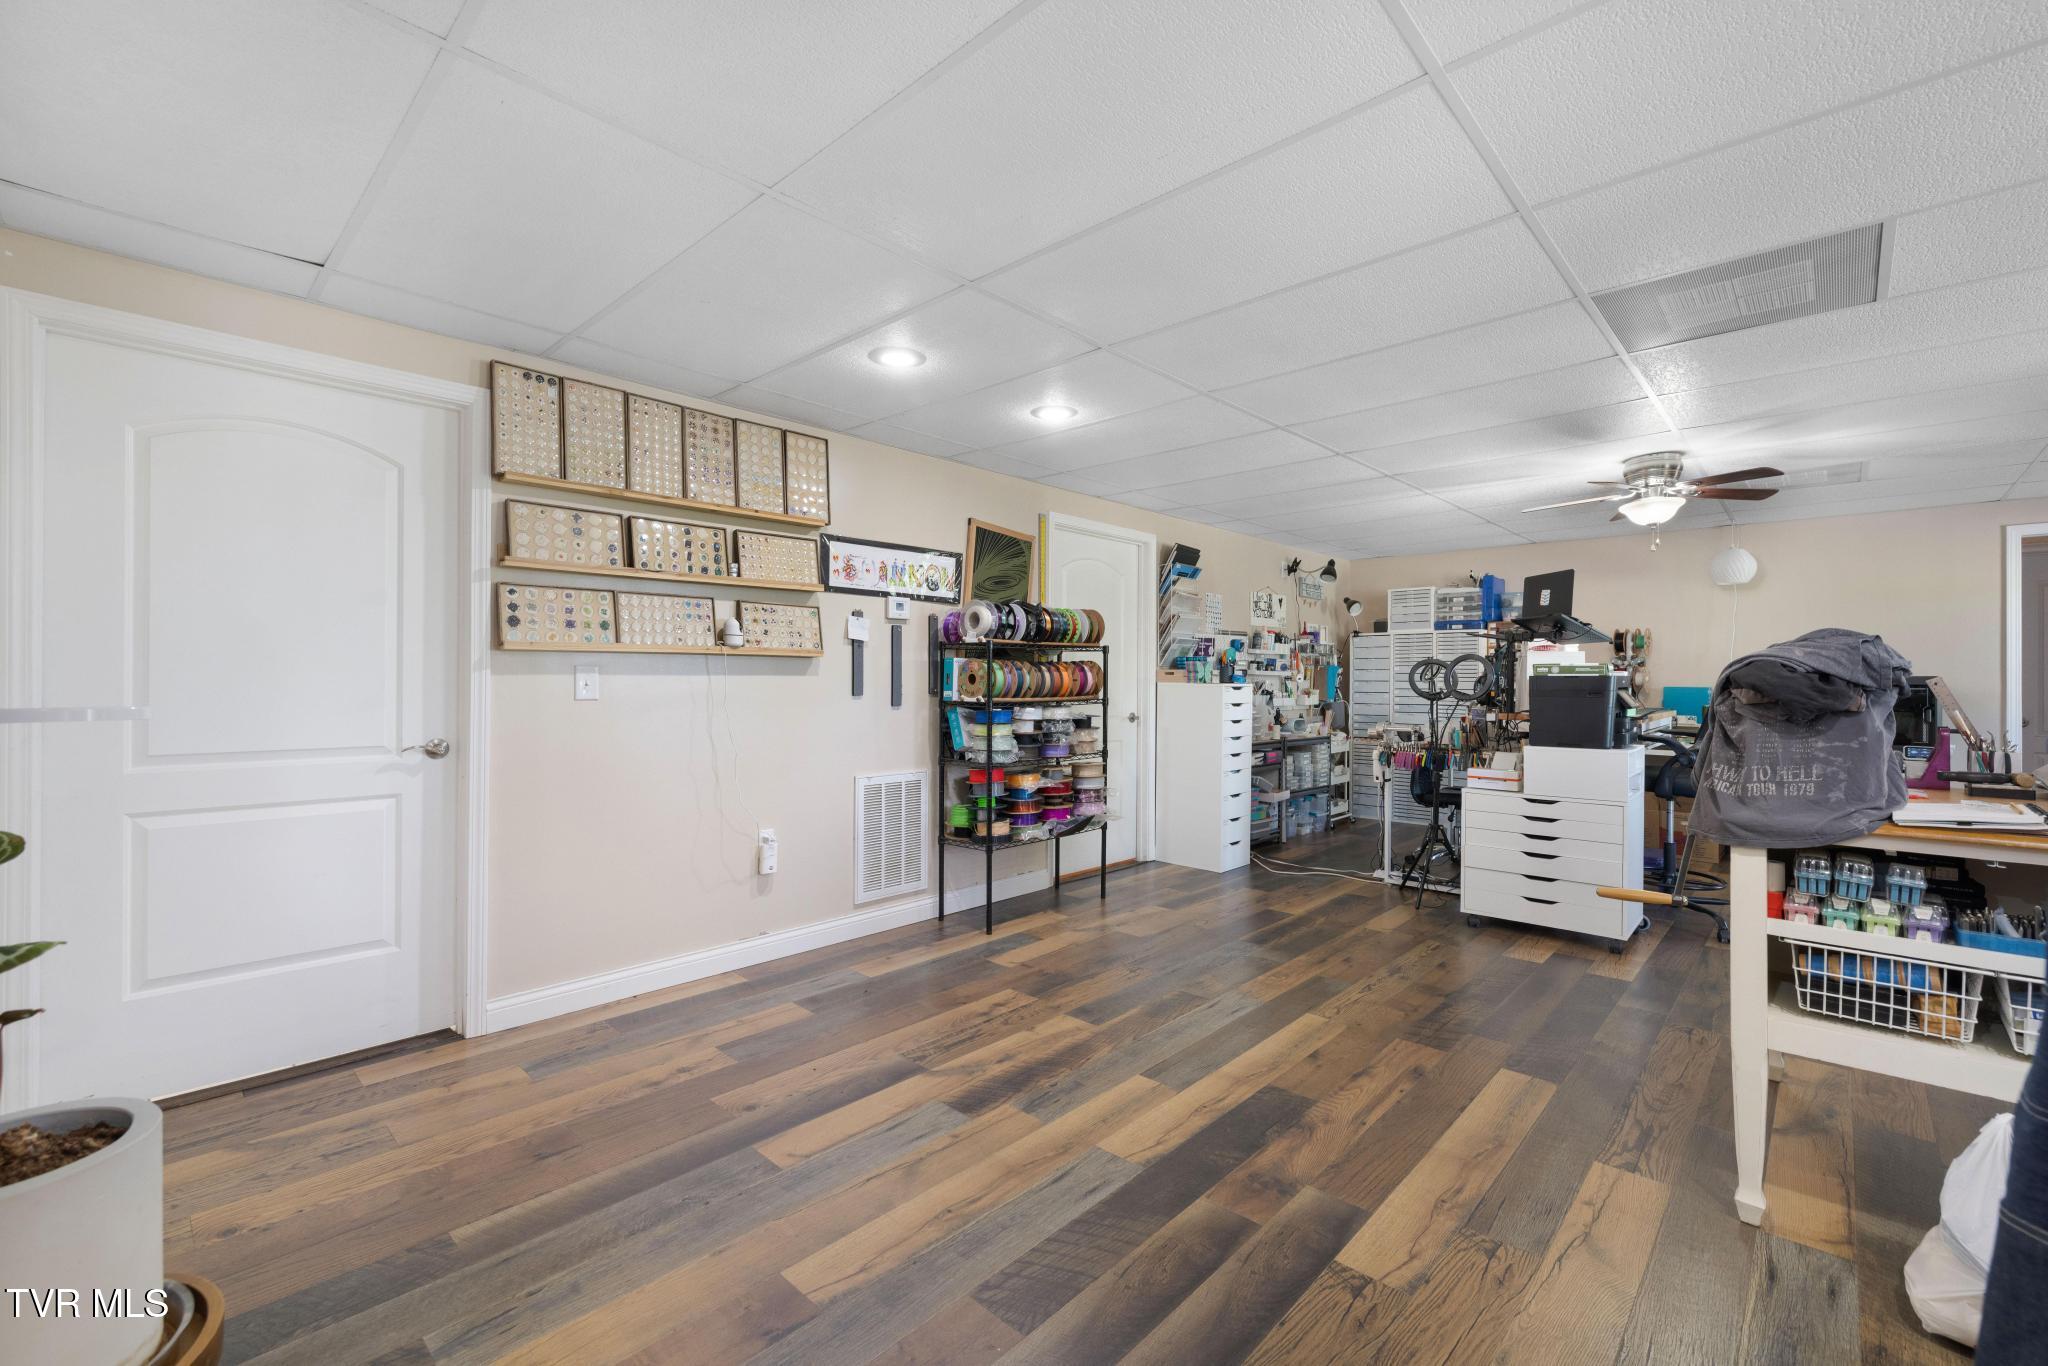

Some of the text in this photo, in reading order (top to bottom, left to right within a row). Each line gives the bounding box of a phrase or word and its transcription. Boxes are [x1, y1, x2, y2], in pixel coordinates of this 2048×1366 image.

[1751, 765, 1771, 781] TO
[1776, 764, 1823, 782] HELL
[1746, 782, 1777, 797] TOUR
[1784, 782, 1815, 797] 1979
